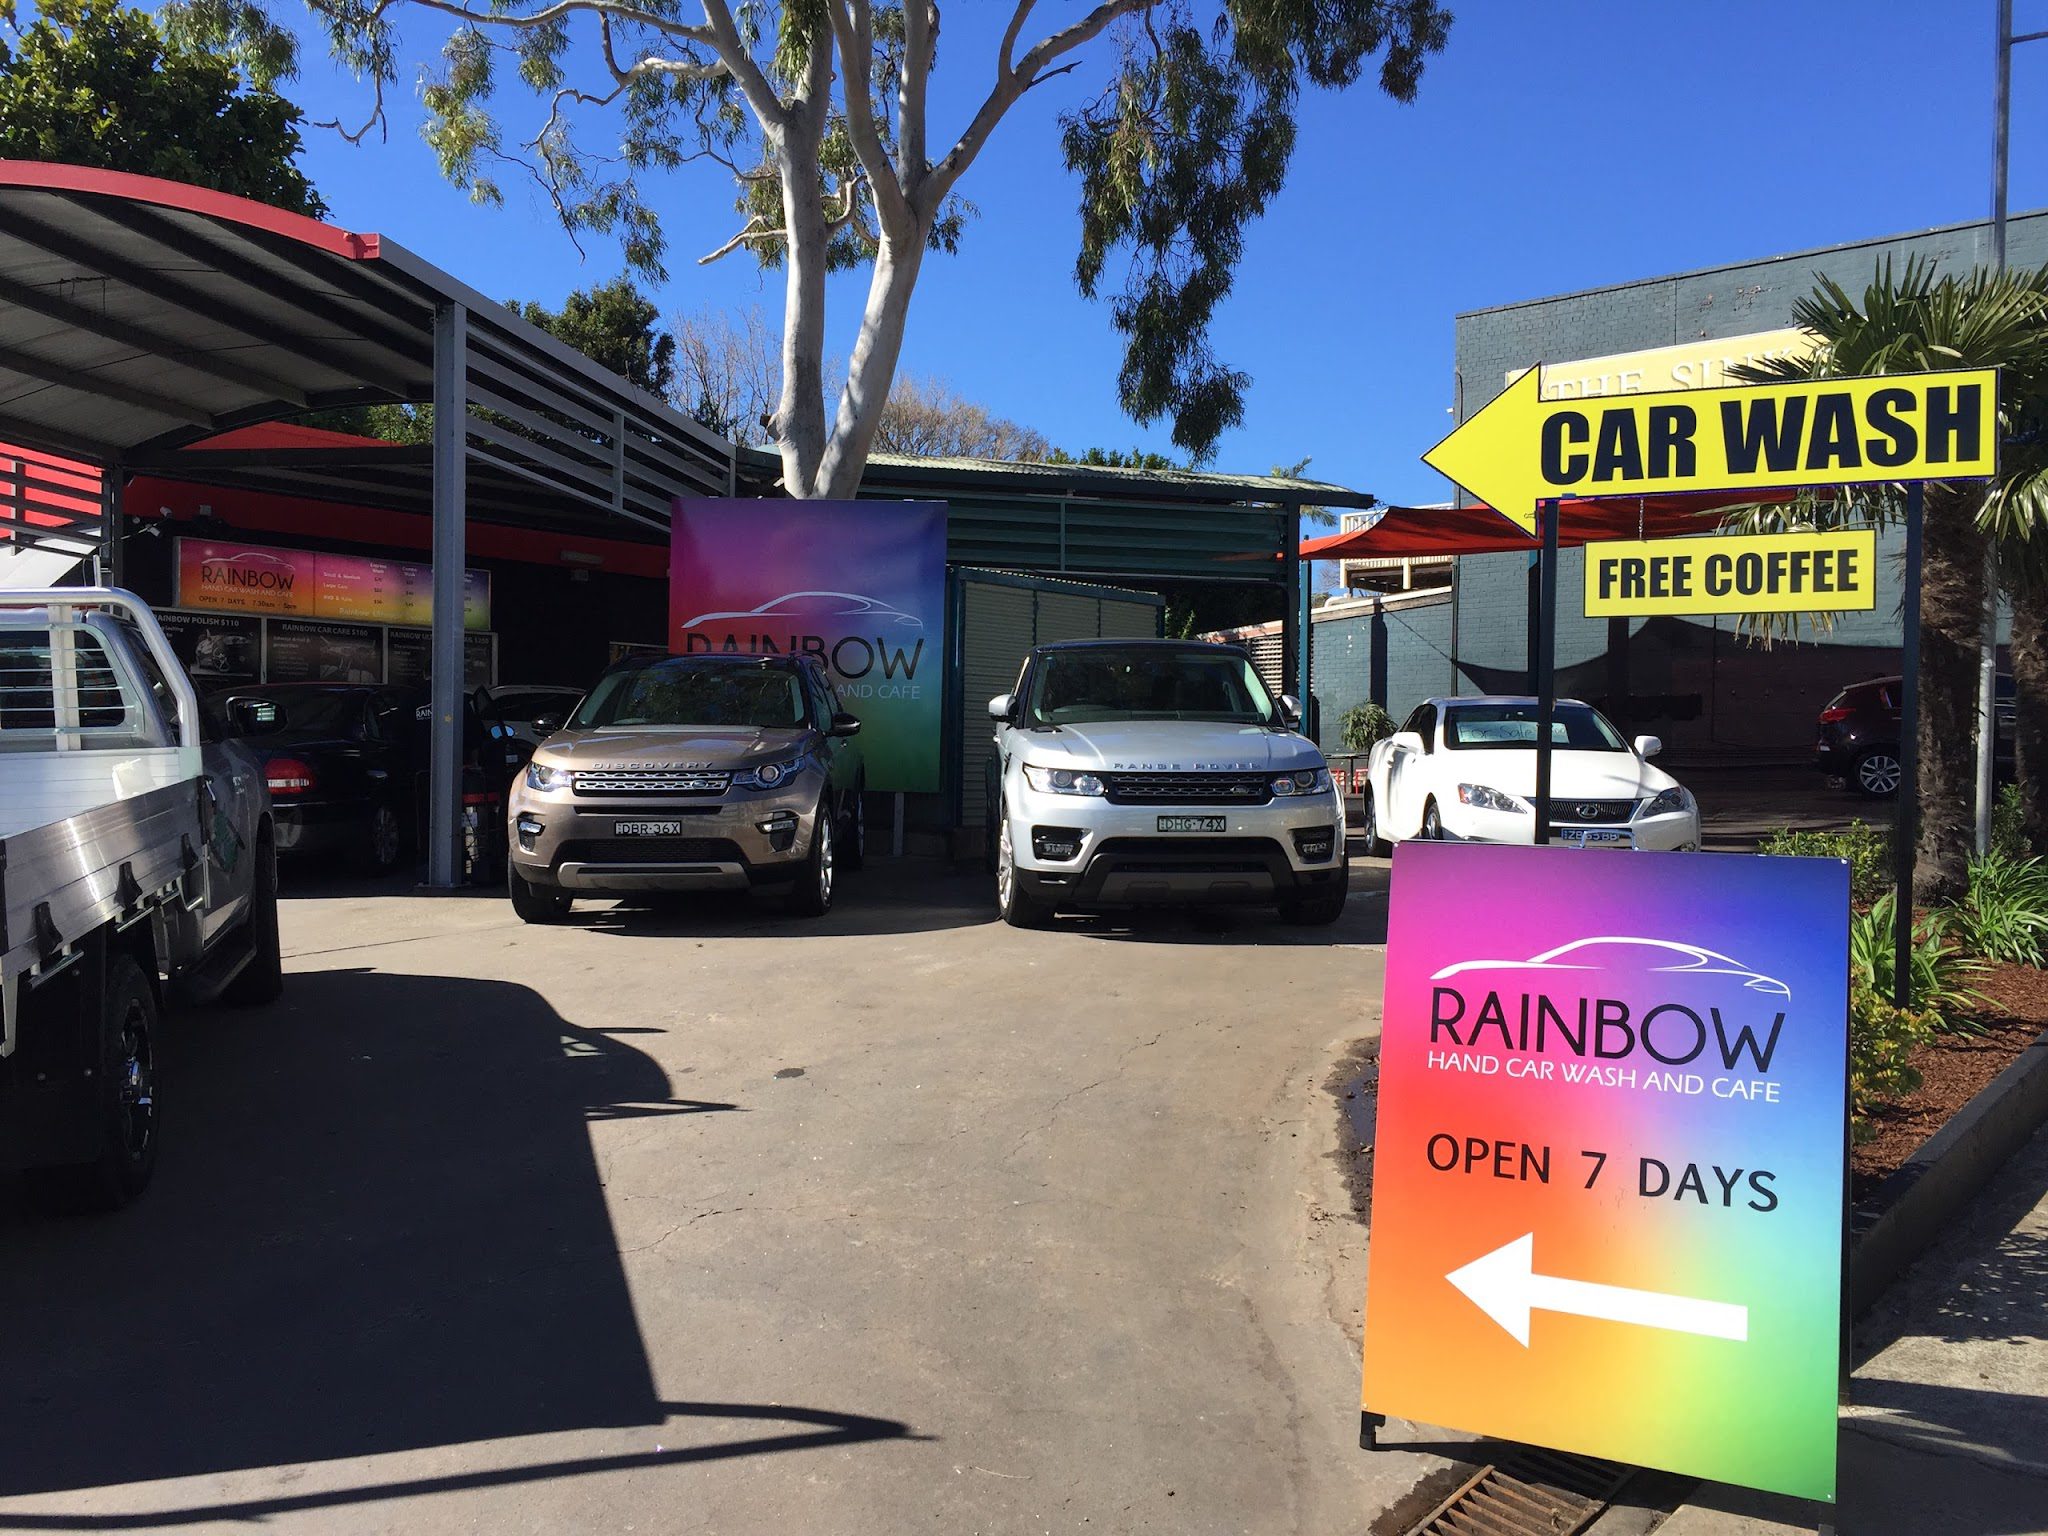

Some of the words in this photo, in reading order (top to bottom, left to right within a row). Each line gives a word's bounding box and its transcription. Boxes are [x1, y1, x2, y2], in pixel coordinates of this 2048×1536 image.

[1549, 368, 1644, 400] THE
[1540, 405, 1698, 485] CAR
[1719, 383, 1982, 475] WASH
[201, 565, 295, 590] RAINBOW
[1599, 556, 1692, 599] FREE
[1704, 548, 1859, 597] COFFEE
[198, 595, 217, 603] OPEN
[201, 584, 223, 592] HAND
[261, 589, 276, 597] AND
[191, 616, 220, 625] POLISH
[220, 619, 240, 627] $110
[282, 623, 317, 633] RAINBOW
[317, 626, 332, 634] CAR
[332, 627, 351, 636] CARE
[837, 684, 873, 698] AND
[877, 684, 921, 700] CAFE
[592, 761, 713, 770] DISCOVERY
[1429, 986, 1786, 1074] RAINBOW
[1427, 1051, 1499, 1076] HAND
[1505, 1058, 1553, 1081] CAR
[1561, 1063, 1636, 1089] WASH
[1643, 1071, 1705, 1096] AND
[1711, 1078, 1781, 1104] CAFE
[1426, 1133, 1551, 1184] OPEN
[1581, 1151, 1608, 1190] 7
[1638, 1158, 1779, 1213] DAYS
